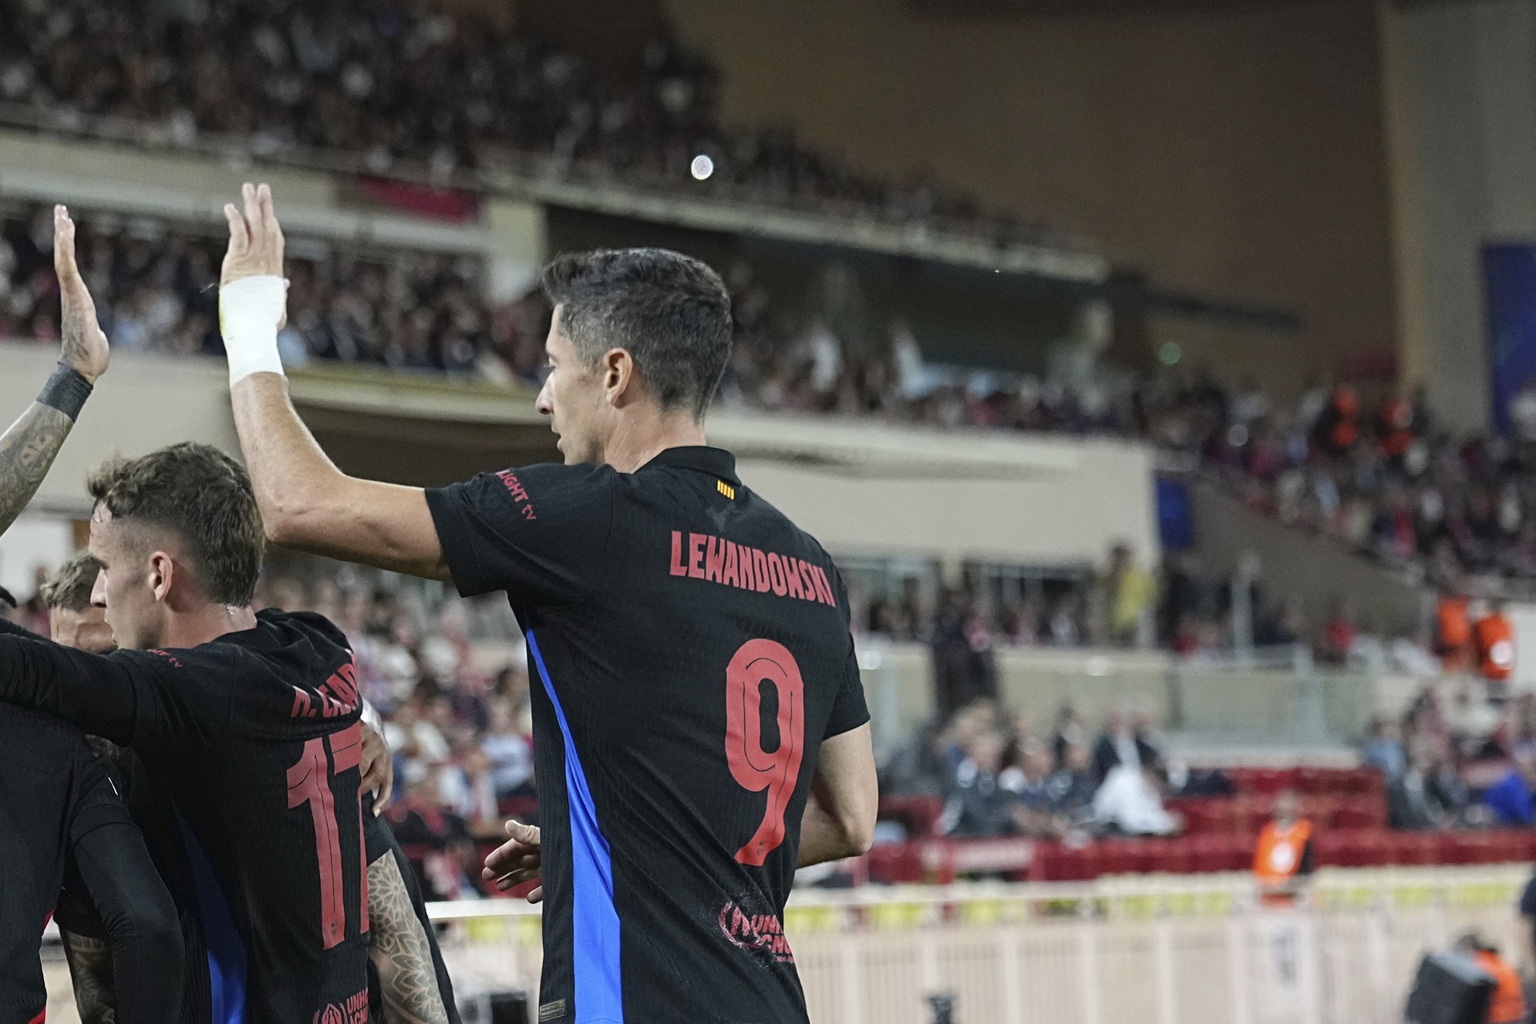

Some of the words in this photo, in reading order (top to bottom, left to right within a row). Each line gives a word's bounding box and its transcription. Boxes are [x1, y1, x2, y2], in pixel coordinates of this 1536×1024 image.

[495, 469, 529, 502] LIGHT
[669, 530, 837, 608] LEWANDOWSKI
[725, 638, 805, 867] 9
